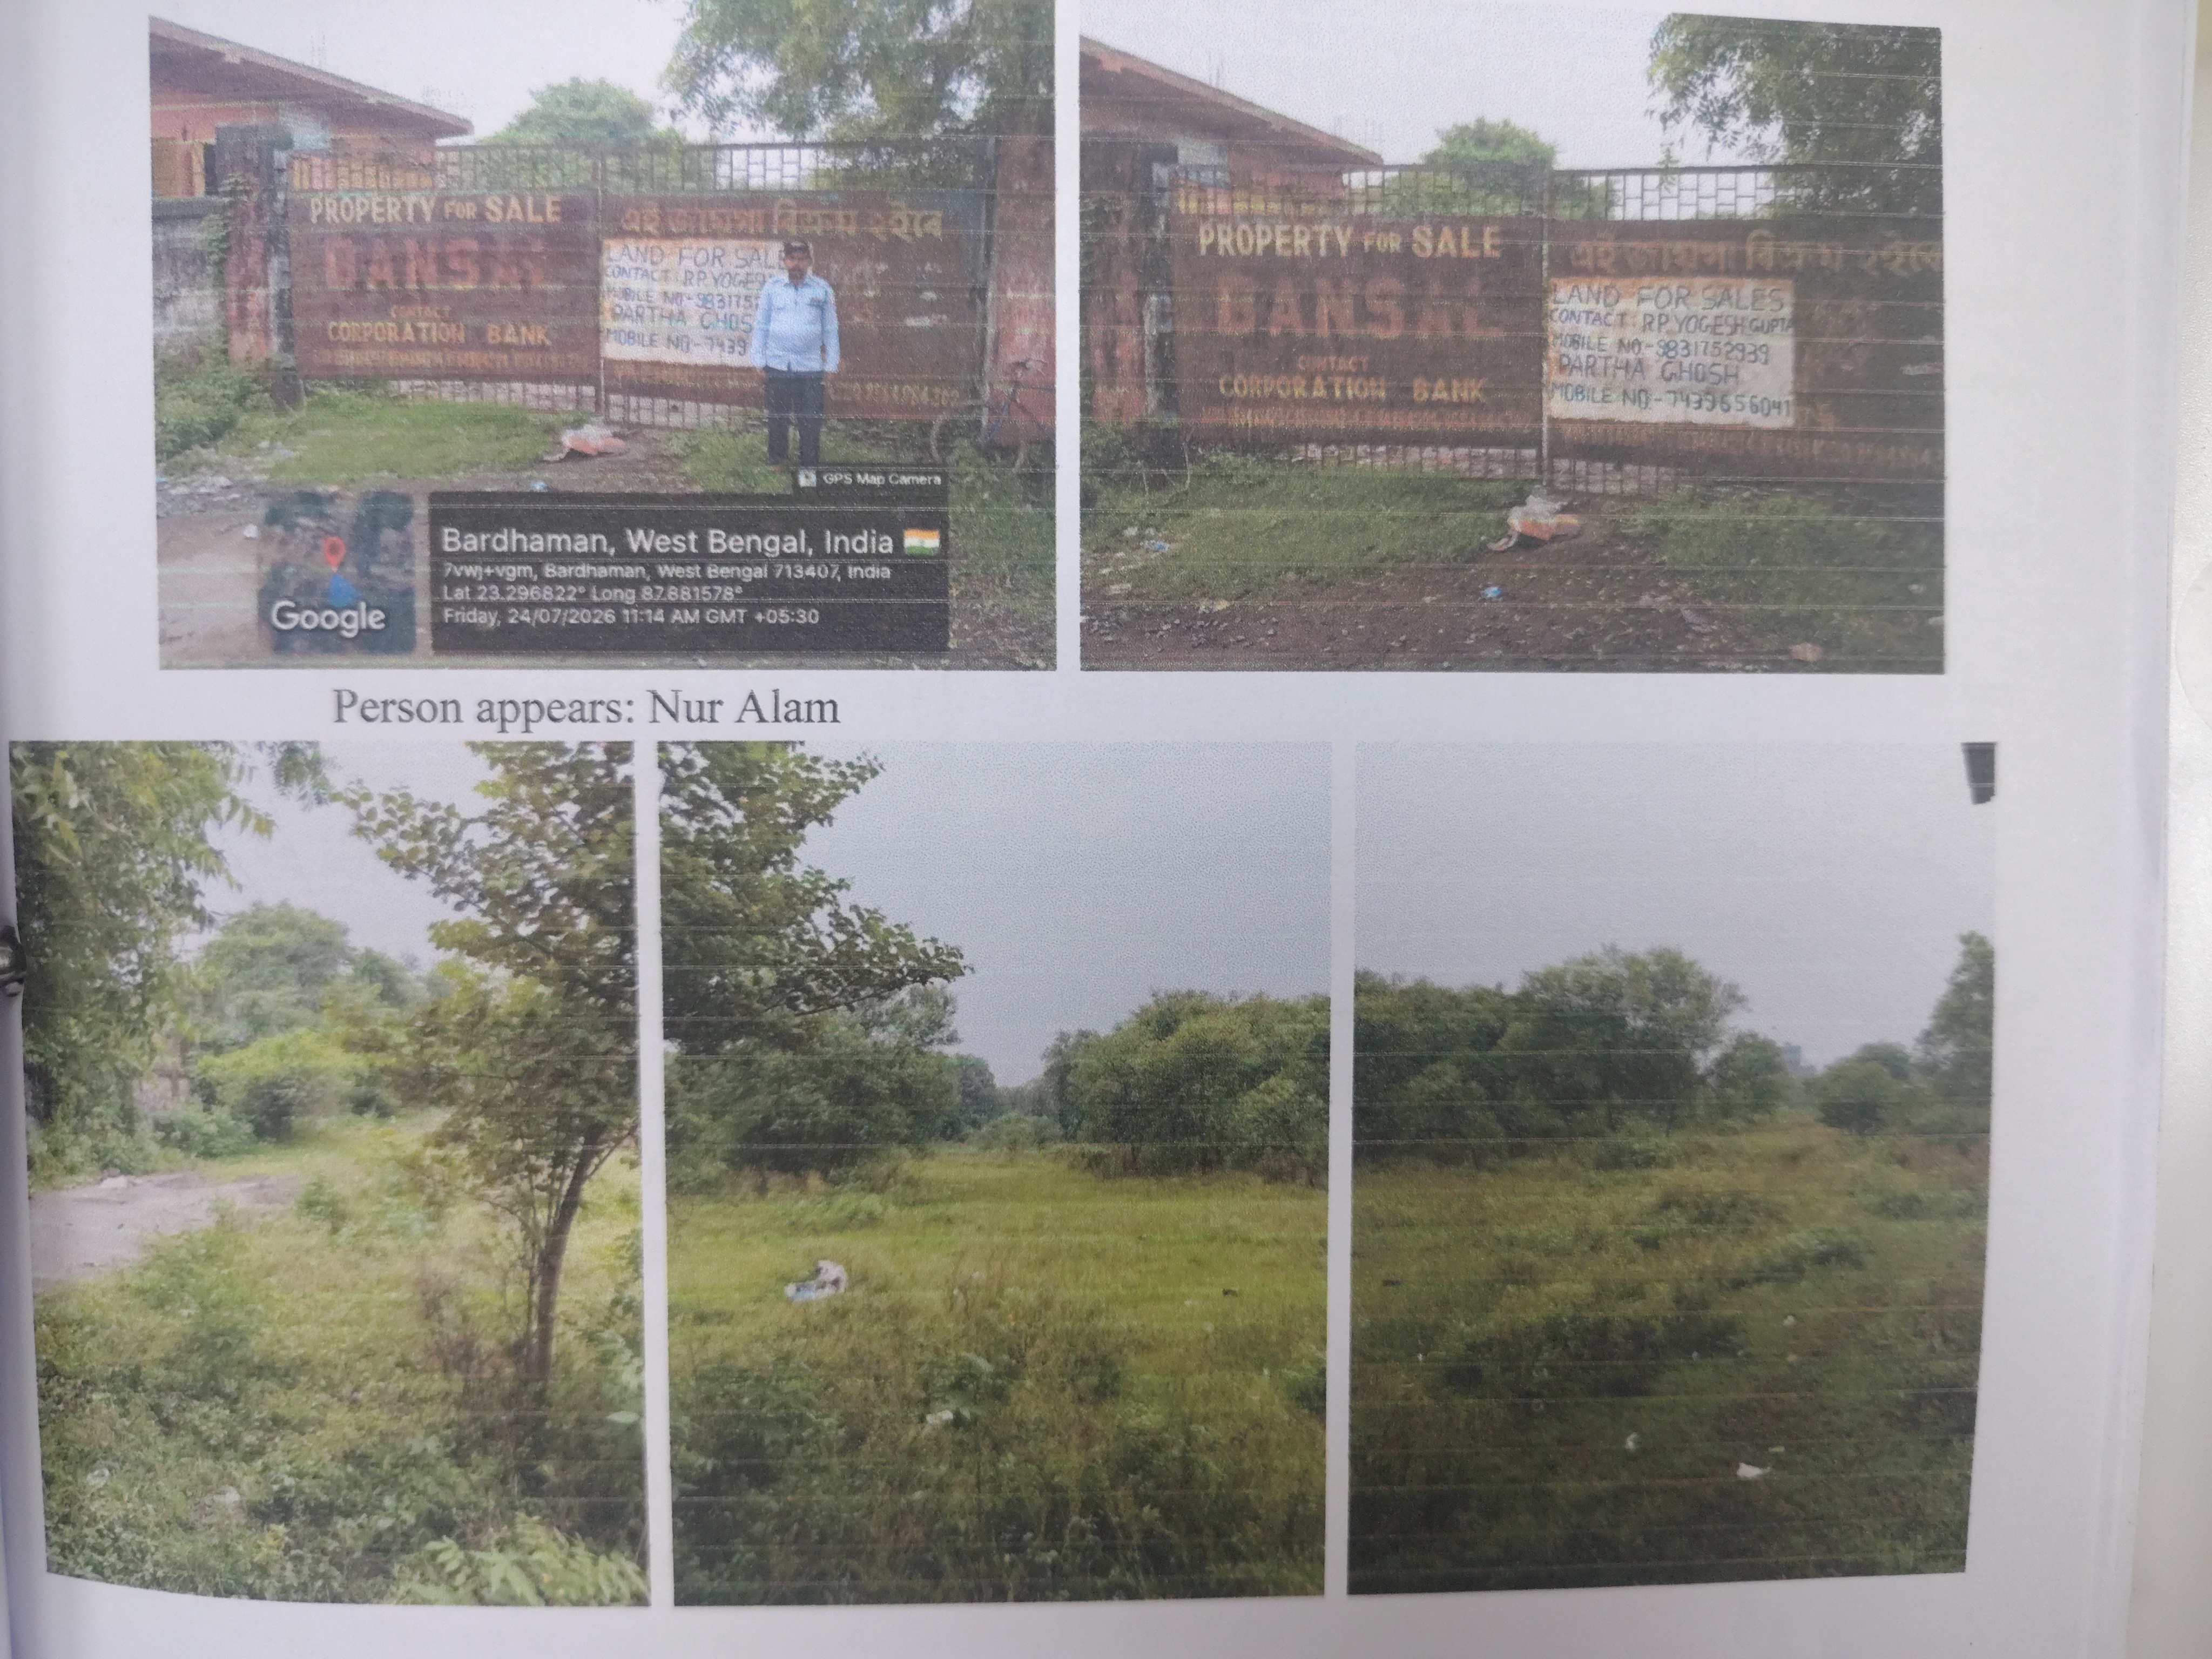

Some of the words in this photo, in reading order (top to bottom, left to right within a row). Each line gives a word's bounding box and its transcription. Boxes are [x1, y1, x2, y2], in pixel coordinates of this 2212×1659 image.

[310, 196, 434, 224] PROPERTY
[444, 201, 476, 219] FOR
[484, 195, 562, 223] SALE
[1199, 224, 1353, 257] PROPERTY
[1364, 231, 1402, 254] FOR
[1413, 225, 1501, 258] SALE
[606, 245, 665, 265] LAND
[678, 246, 727, 268] FOR
[1552, 284, 1620, 308] LAND
[1636, 286, 1691, 310] FOR
[1702, 285, 1785, 312] SALES
[611, 303, 687, 325] PARTHA
[327, 321, 466, 344] CORPORATION
[487, 323, 552, 346] BANK
[606, 327, 659, 347] MOBILE
[1551, 333, 1608, 352] MOBILE
[1559, 354, 1645, 380] PARTHA
[1661, 361, 1739, 386] GHOSH
[1219, 375, 1386, 399] CORPORATION
[1413, 377, 1488, 403] BANK
[1550, 382, 1612, 404] MOBILE
[333, 689, 463, 723] Person
[476, 698, 635, 733] appears:
[647, 690, 724, 723] Nur
[735, 689, 841, 723] Alam
